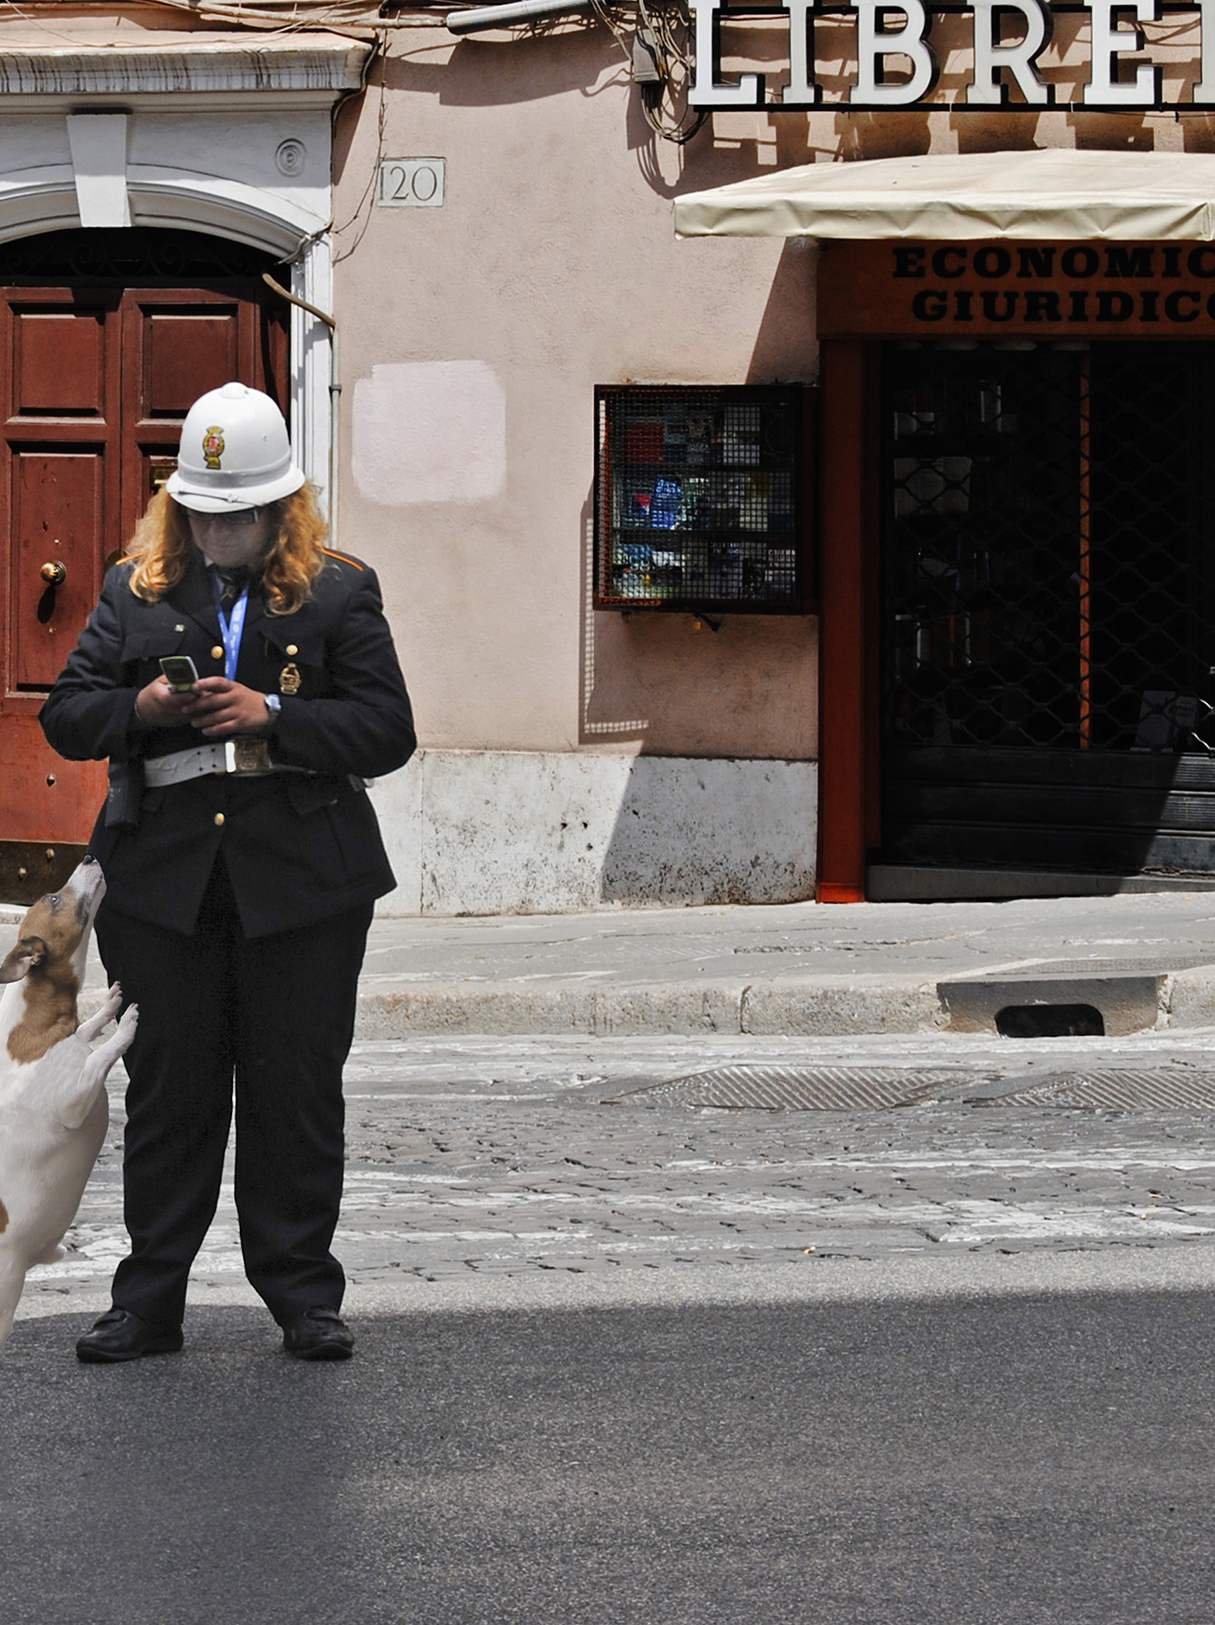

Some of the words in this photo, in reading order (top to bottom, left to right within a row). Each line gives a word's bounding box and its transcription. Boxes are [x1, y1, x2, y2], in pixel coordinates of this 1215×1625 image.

[688, 0, 1215, 105] LIBRE
[379, 165, 438, 202] 120
[912, 289, 1215, 322] GIURIDIC
